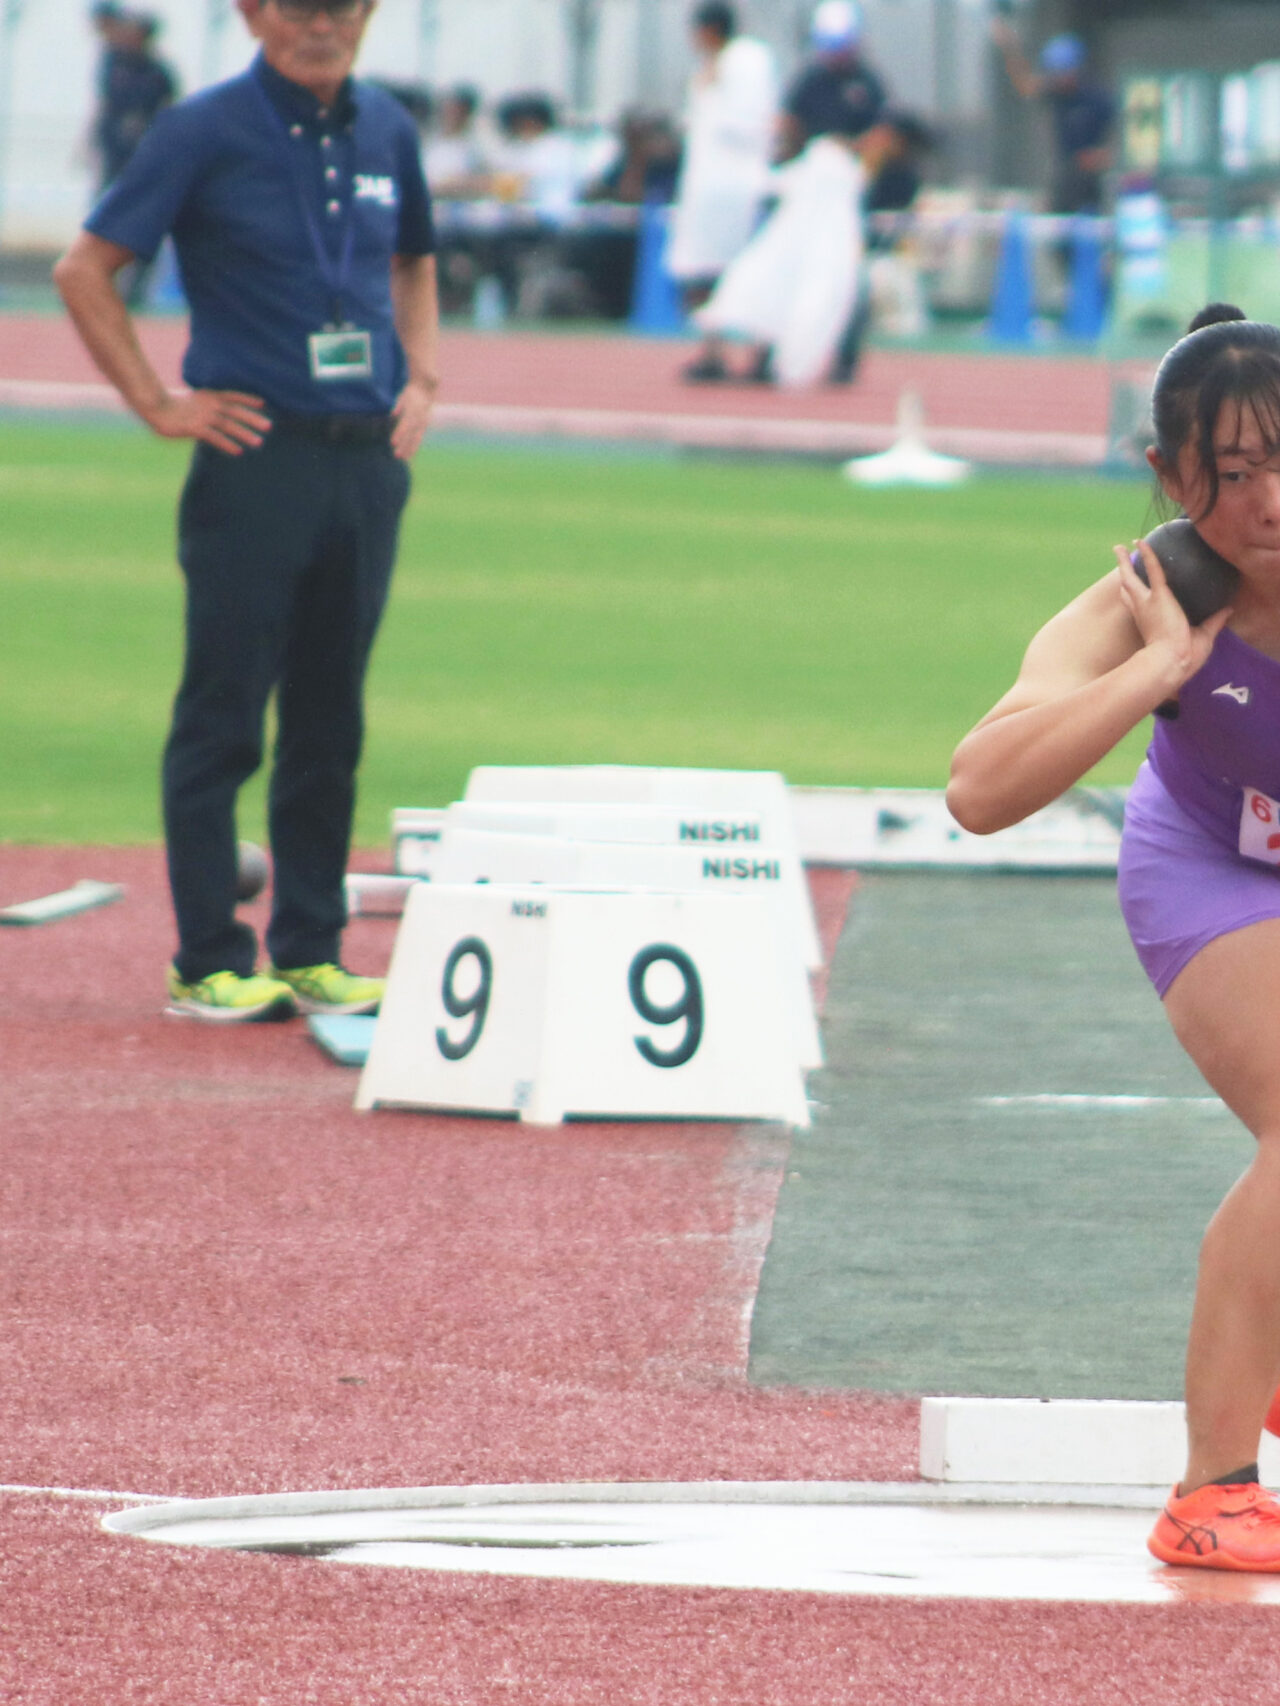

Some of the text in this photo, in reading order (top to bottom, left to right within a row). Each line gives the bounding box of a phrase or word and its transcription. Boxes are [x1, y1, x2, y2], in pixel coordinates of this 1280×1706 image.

[1251, 794, 1272, 823] 6
[679, 820, 761, 842] NISHI
[702, 857, 781, 880] NISHI
[435, 934, 494, 1061] 9
[627, 941, 705, 1068] 9
